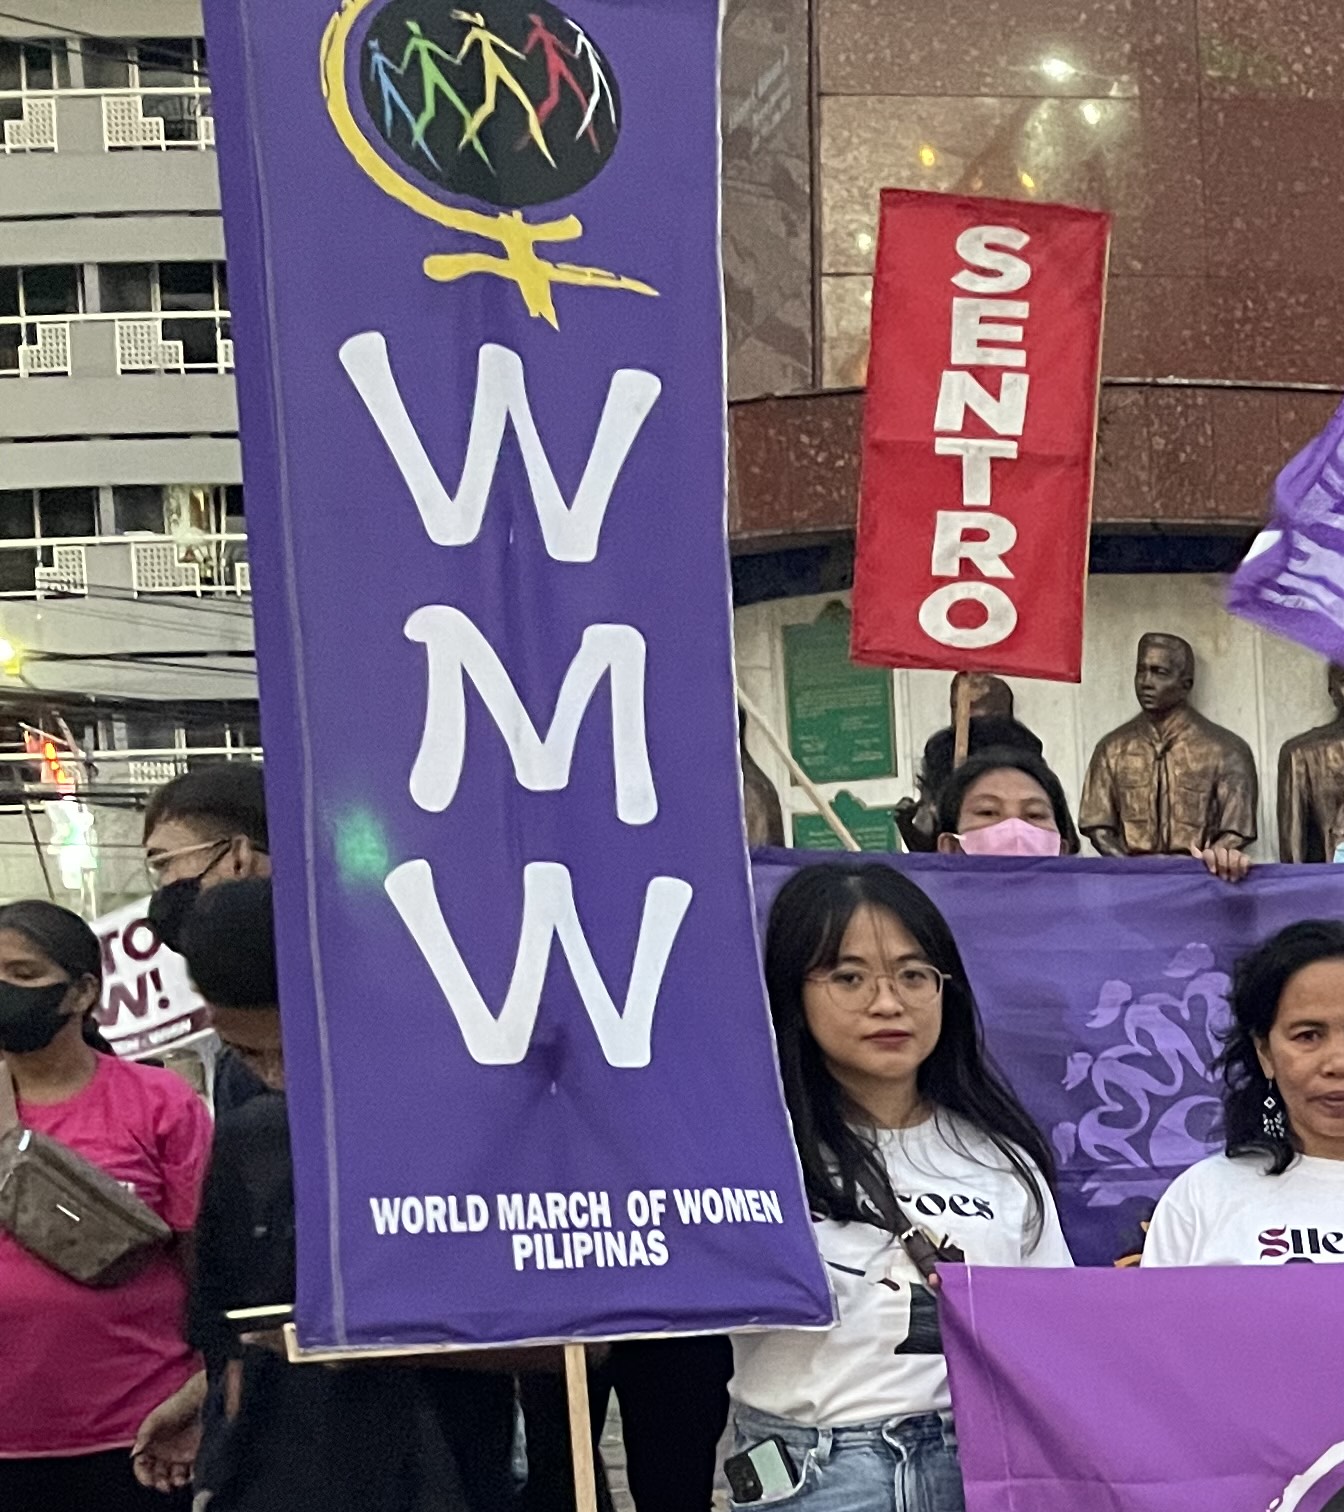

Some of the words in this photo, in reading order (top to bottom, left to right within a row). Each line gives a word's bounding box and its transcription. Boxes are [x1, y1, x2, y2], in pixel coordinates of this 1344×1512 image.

[918, 225, 1031, 649] SENTRO
[339, 330, 694, 1069] WMW
[369, 1194, 490, 1235] WORLD
[497, 1191, 613, 1231] MARCH
[626, 1188, 667, 1228] OF
[673, 1187, 785, 1225] WOMEN
[511, 1229, 670, 1271] PILIPINAS
